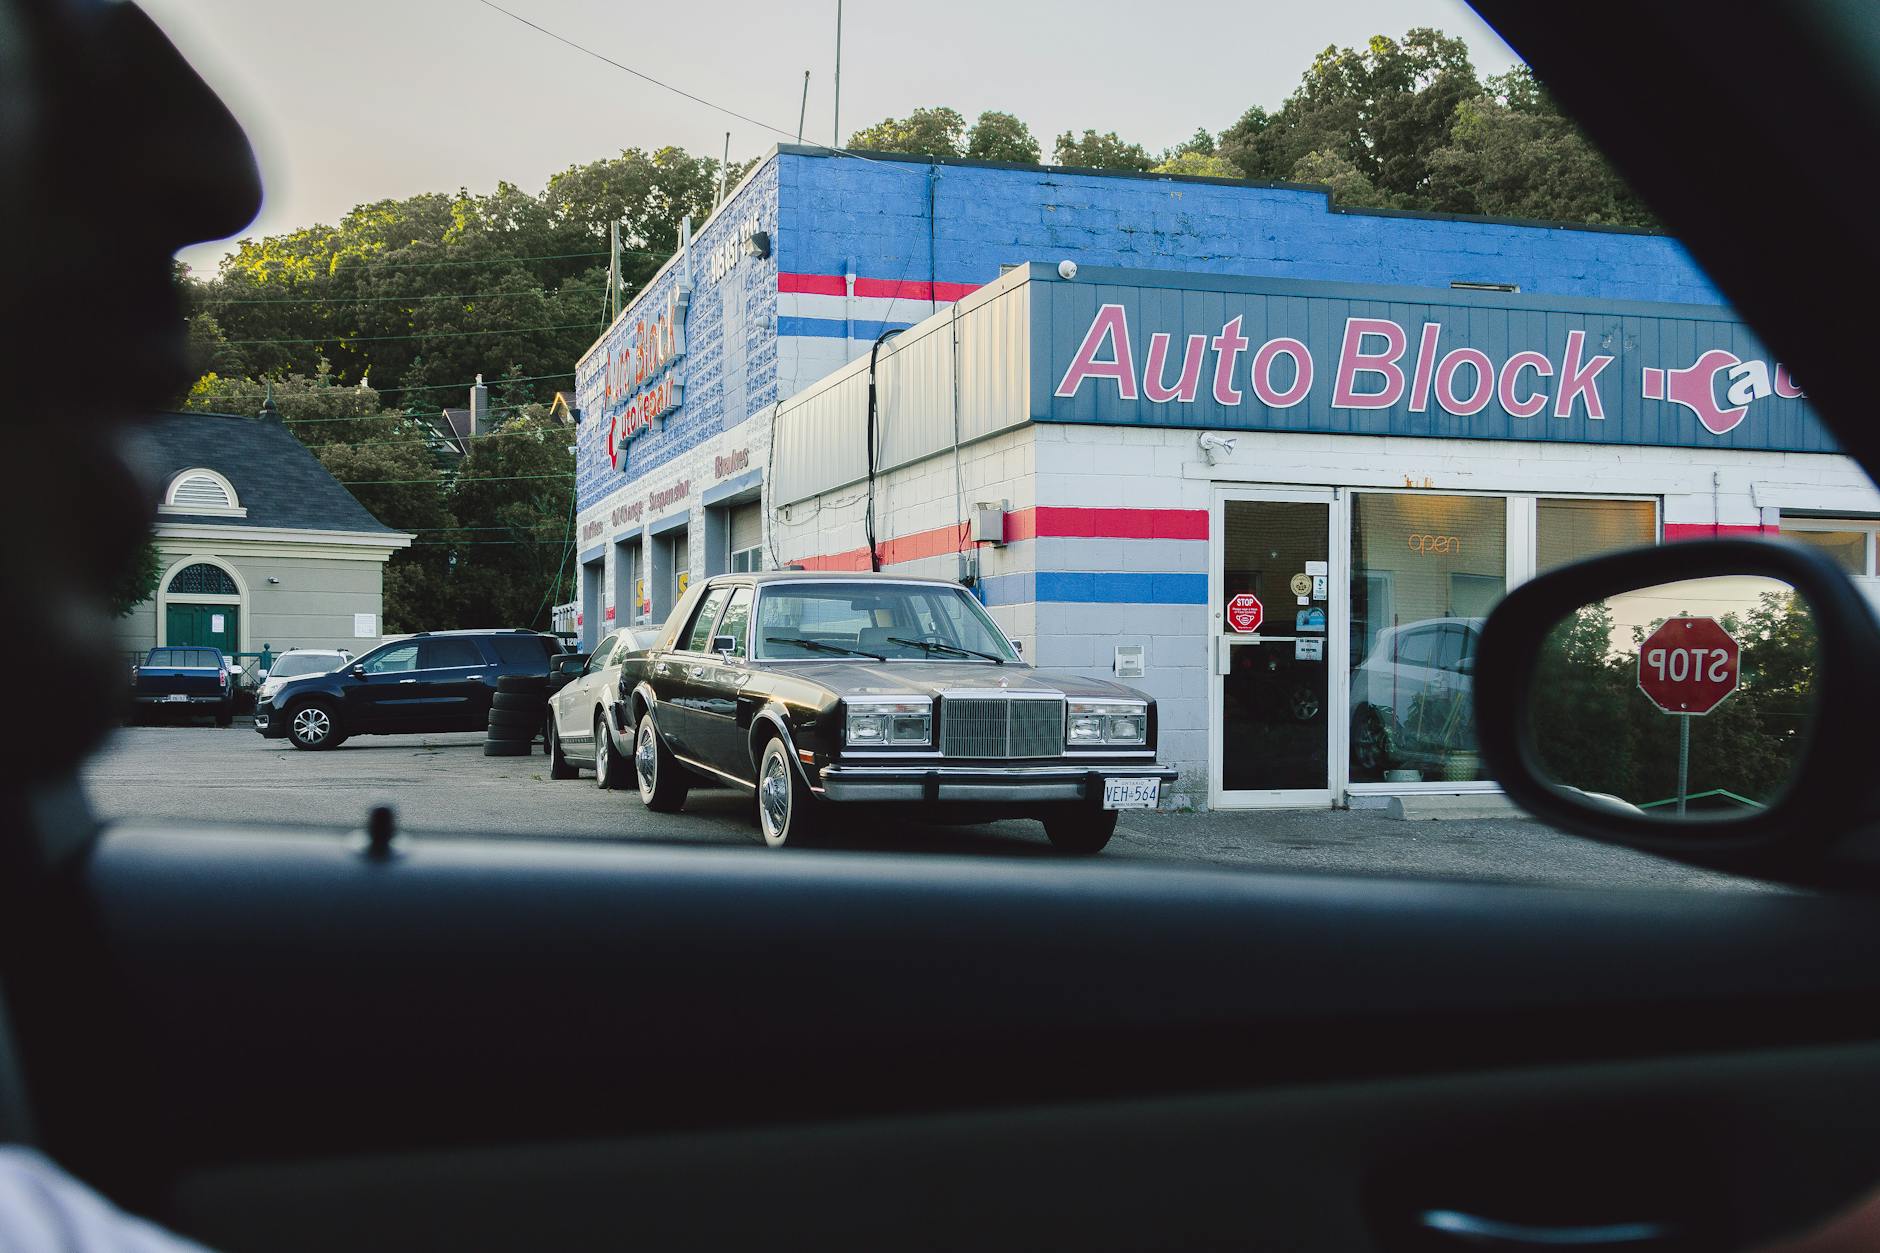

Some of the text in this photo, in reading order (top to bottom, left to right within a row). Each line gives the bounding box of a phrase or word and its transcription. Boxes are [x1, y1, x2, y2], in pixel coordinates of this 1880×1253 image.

[604, 288, 676, 410] Auto Block
[1054, 303, 1615, 420] Auto Block
[637, 375, 674, 431] Repair
[714, 449, 750, 479] Brakes
[649, 479, 690, 514] Suspension
[1408, 534, 1460, 557] open
[1236, 598, 1254, 606] STOP
